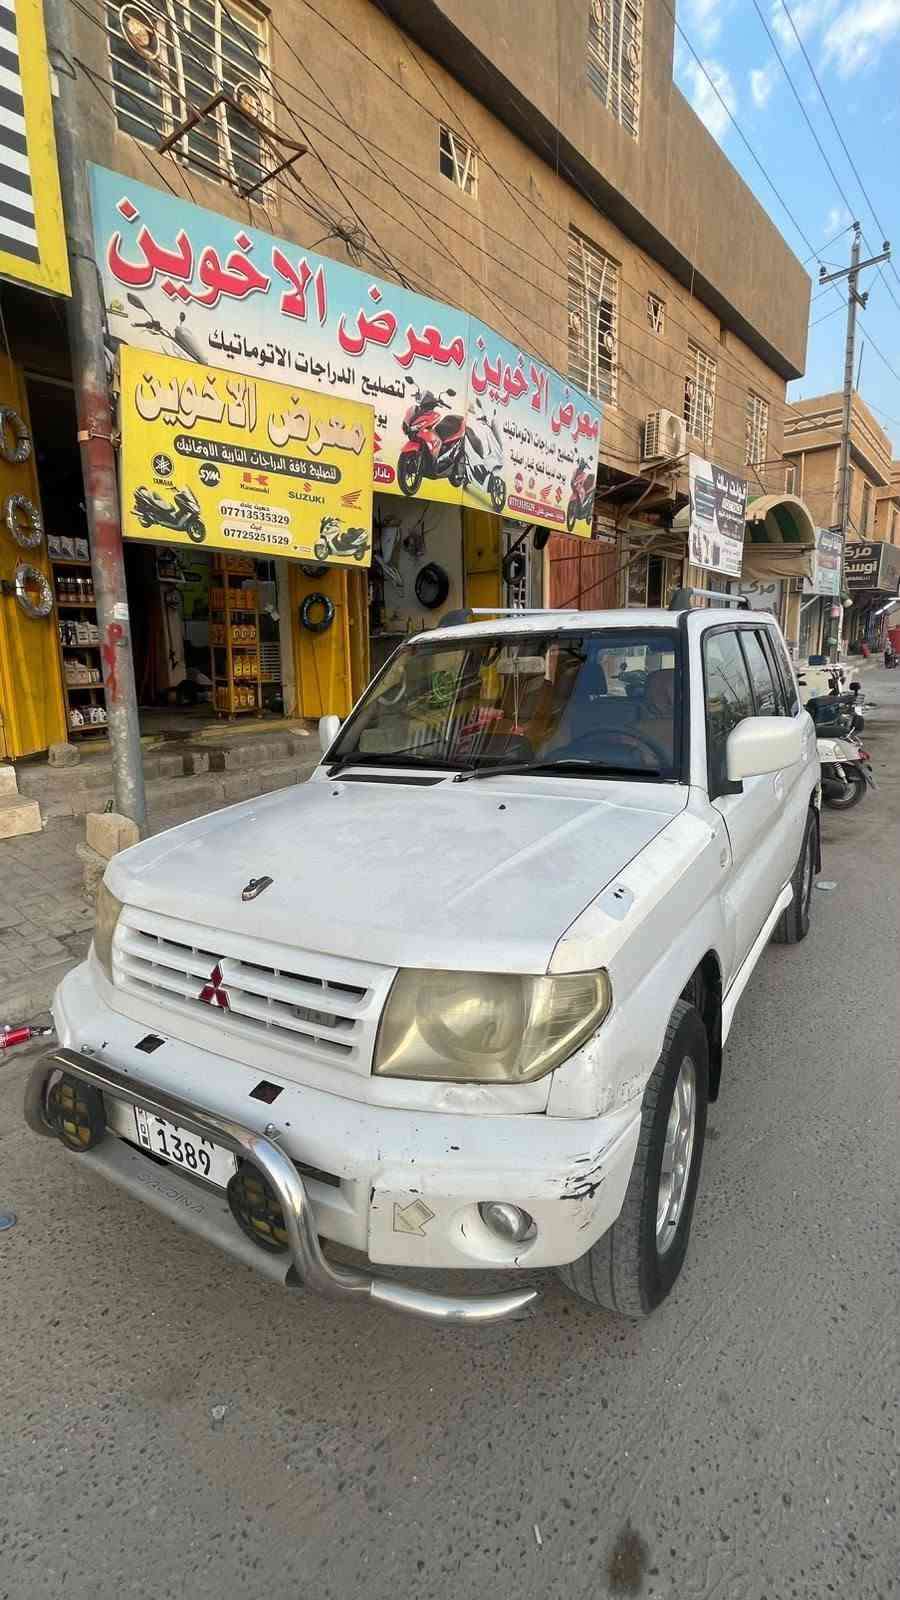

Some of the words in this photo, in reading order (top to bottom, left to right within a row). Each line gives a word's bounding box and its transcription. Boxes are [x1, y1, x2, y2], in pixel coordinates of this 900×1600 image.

[106, 196, 327, 326] الاخوين
[337, 284, 465, 369] معرض
[208, 329, 291, 368] الاتوماتيك
[294, 351, 356, 385] الدراجات
[471, 336, 549, 416] الاخوين
[135, 373, 257, 433] الاخوين
[551, 387, 599, 443] معرض
[267, 394, 366, 456] معرض
[199, 469, 219, 482] SYM
[249, 453, 286, 472] الدراجات
[220, 506, 290, 525] 07713535329
[288, 491, 325, 504] SUZUKI
[223, 528, 289, 545] 07725251529
[844, 545, 872, 559] مرك
[157, 1128, 211, 1176] 1389
